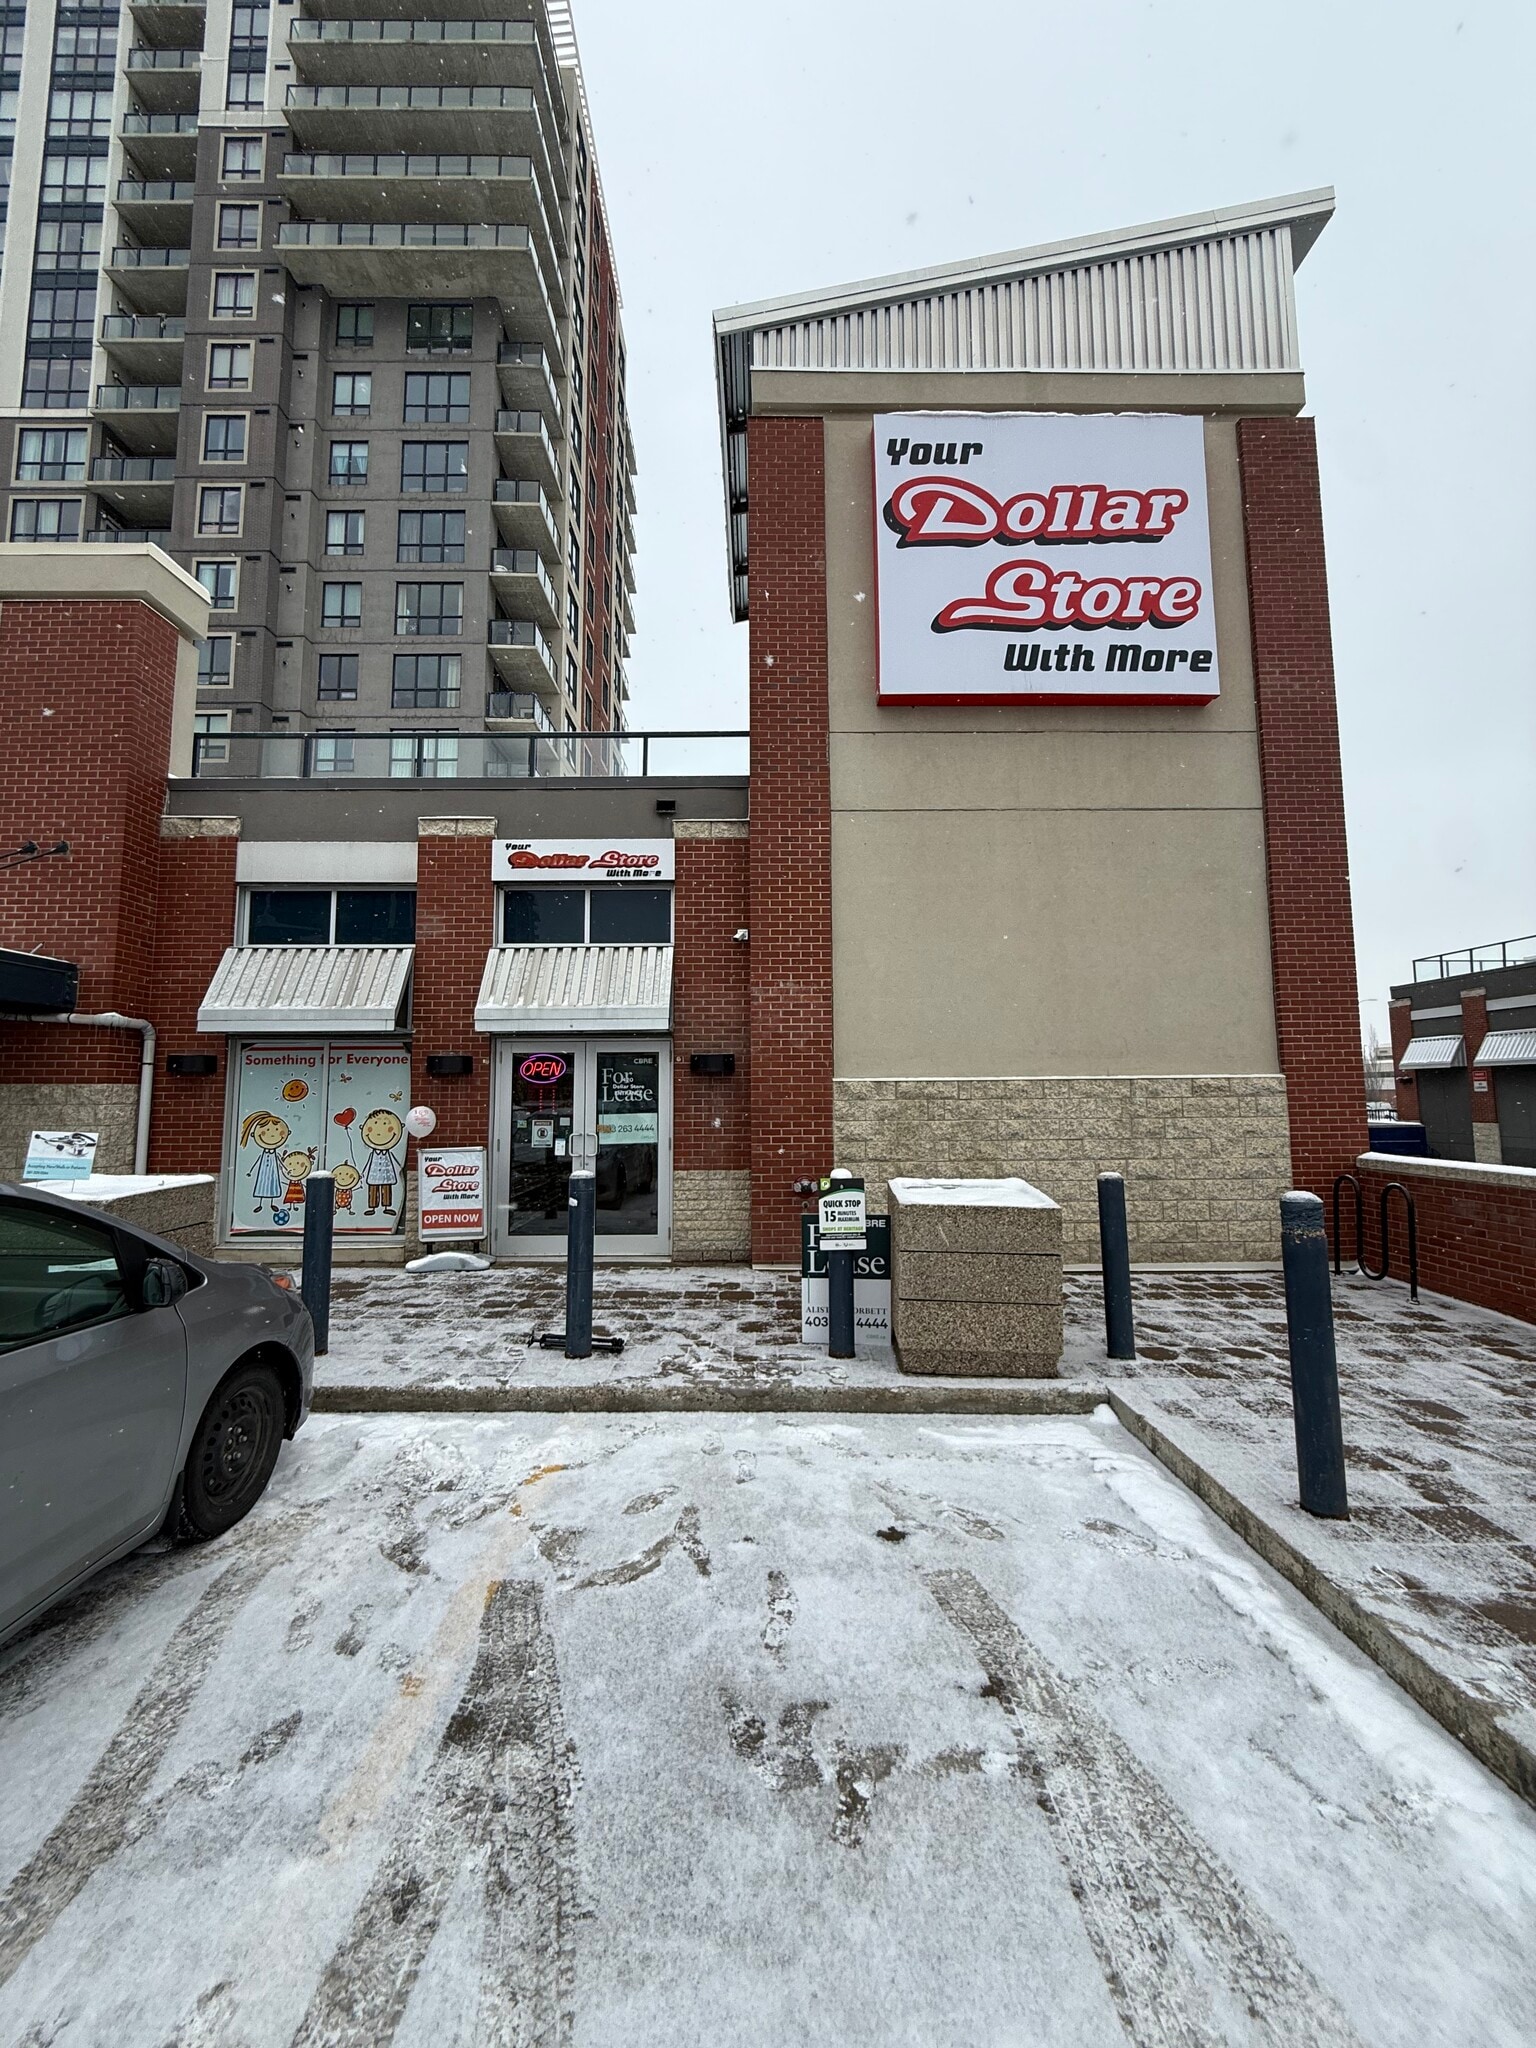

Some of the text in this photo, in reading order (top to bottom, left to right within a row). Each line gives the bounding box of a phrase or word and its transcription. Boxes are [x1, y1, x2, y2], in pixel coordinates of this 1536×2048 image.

[886, 438, 983, 466] Your
[883, 475, 1189, 549] Dollar
[931, 559, 1202, 634] Store
[1003, 644, 1213, 672] With More
[508, 851, 659, 869] Dollar Store
[606, 869, 631, 877] With
[245, 1054, 316, 1067] Something
[346, 1054, 409, 1067] Everyone
[523, 1061, 562, 1076] OPEN
[602, 1068, 633, 1084] For
[602, 1086, 653, 1102] Lease
[618, 1124, 632, 1132] 263
[634, 1124, 654, 1132] 4444
[425, 1164, 480, 1177] Dollar
[432, 1179, 479, 1193] Store
[823, 1200, 861, 1208] QUICK STOP
[424, 1213, 479, 1224] OPEN NOW
[824, 1211, 836, 1222] 15
[866, 1219, 886, 1228] BRE
[807, 1250, 885, 1274] Lse
[804, 1316, 888, 1329] 403 4444
